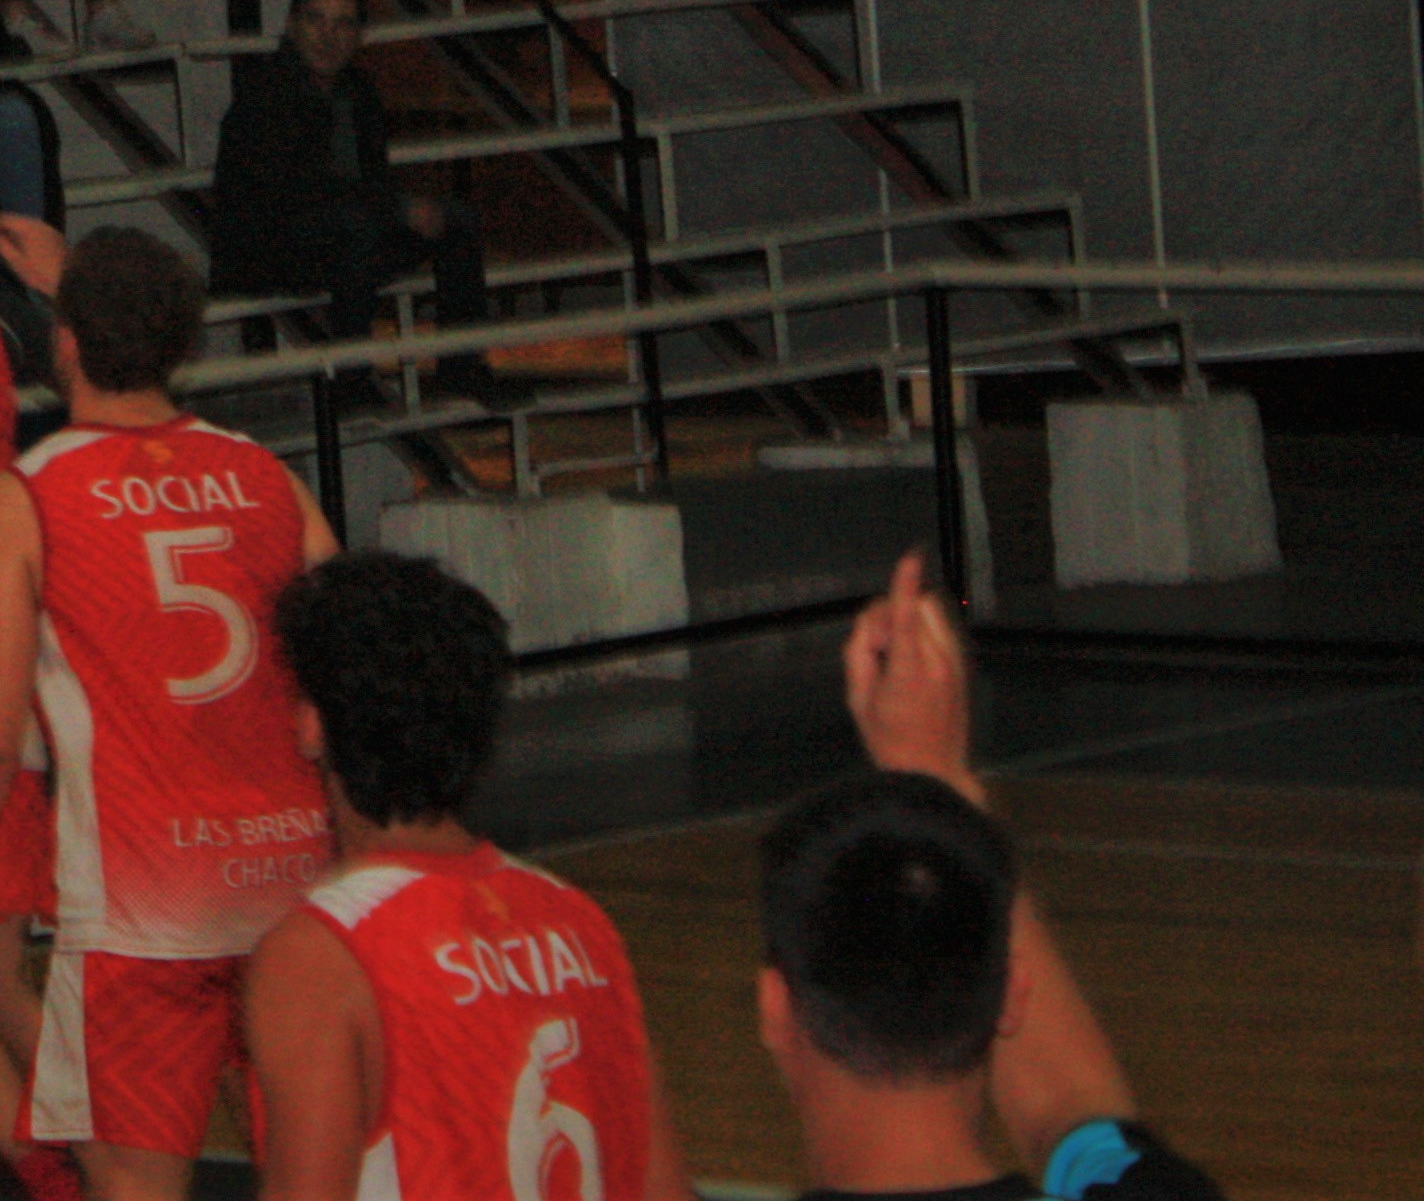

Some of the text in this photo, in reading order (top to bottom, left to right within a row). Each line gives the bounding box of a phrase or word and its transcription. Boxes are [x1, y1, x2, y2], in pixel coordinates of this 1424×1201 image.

[90, 470, 260, 520] SOCIAL
[140, 525, 259, 705] 5
[172, 817, 233, 848] LAS
[223, 852, 317, 889] CHACO
[433, 921, 609, 1005] SOCIAL
[506, 1017, 607, 1201] 6
